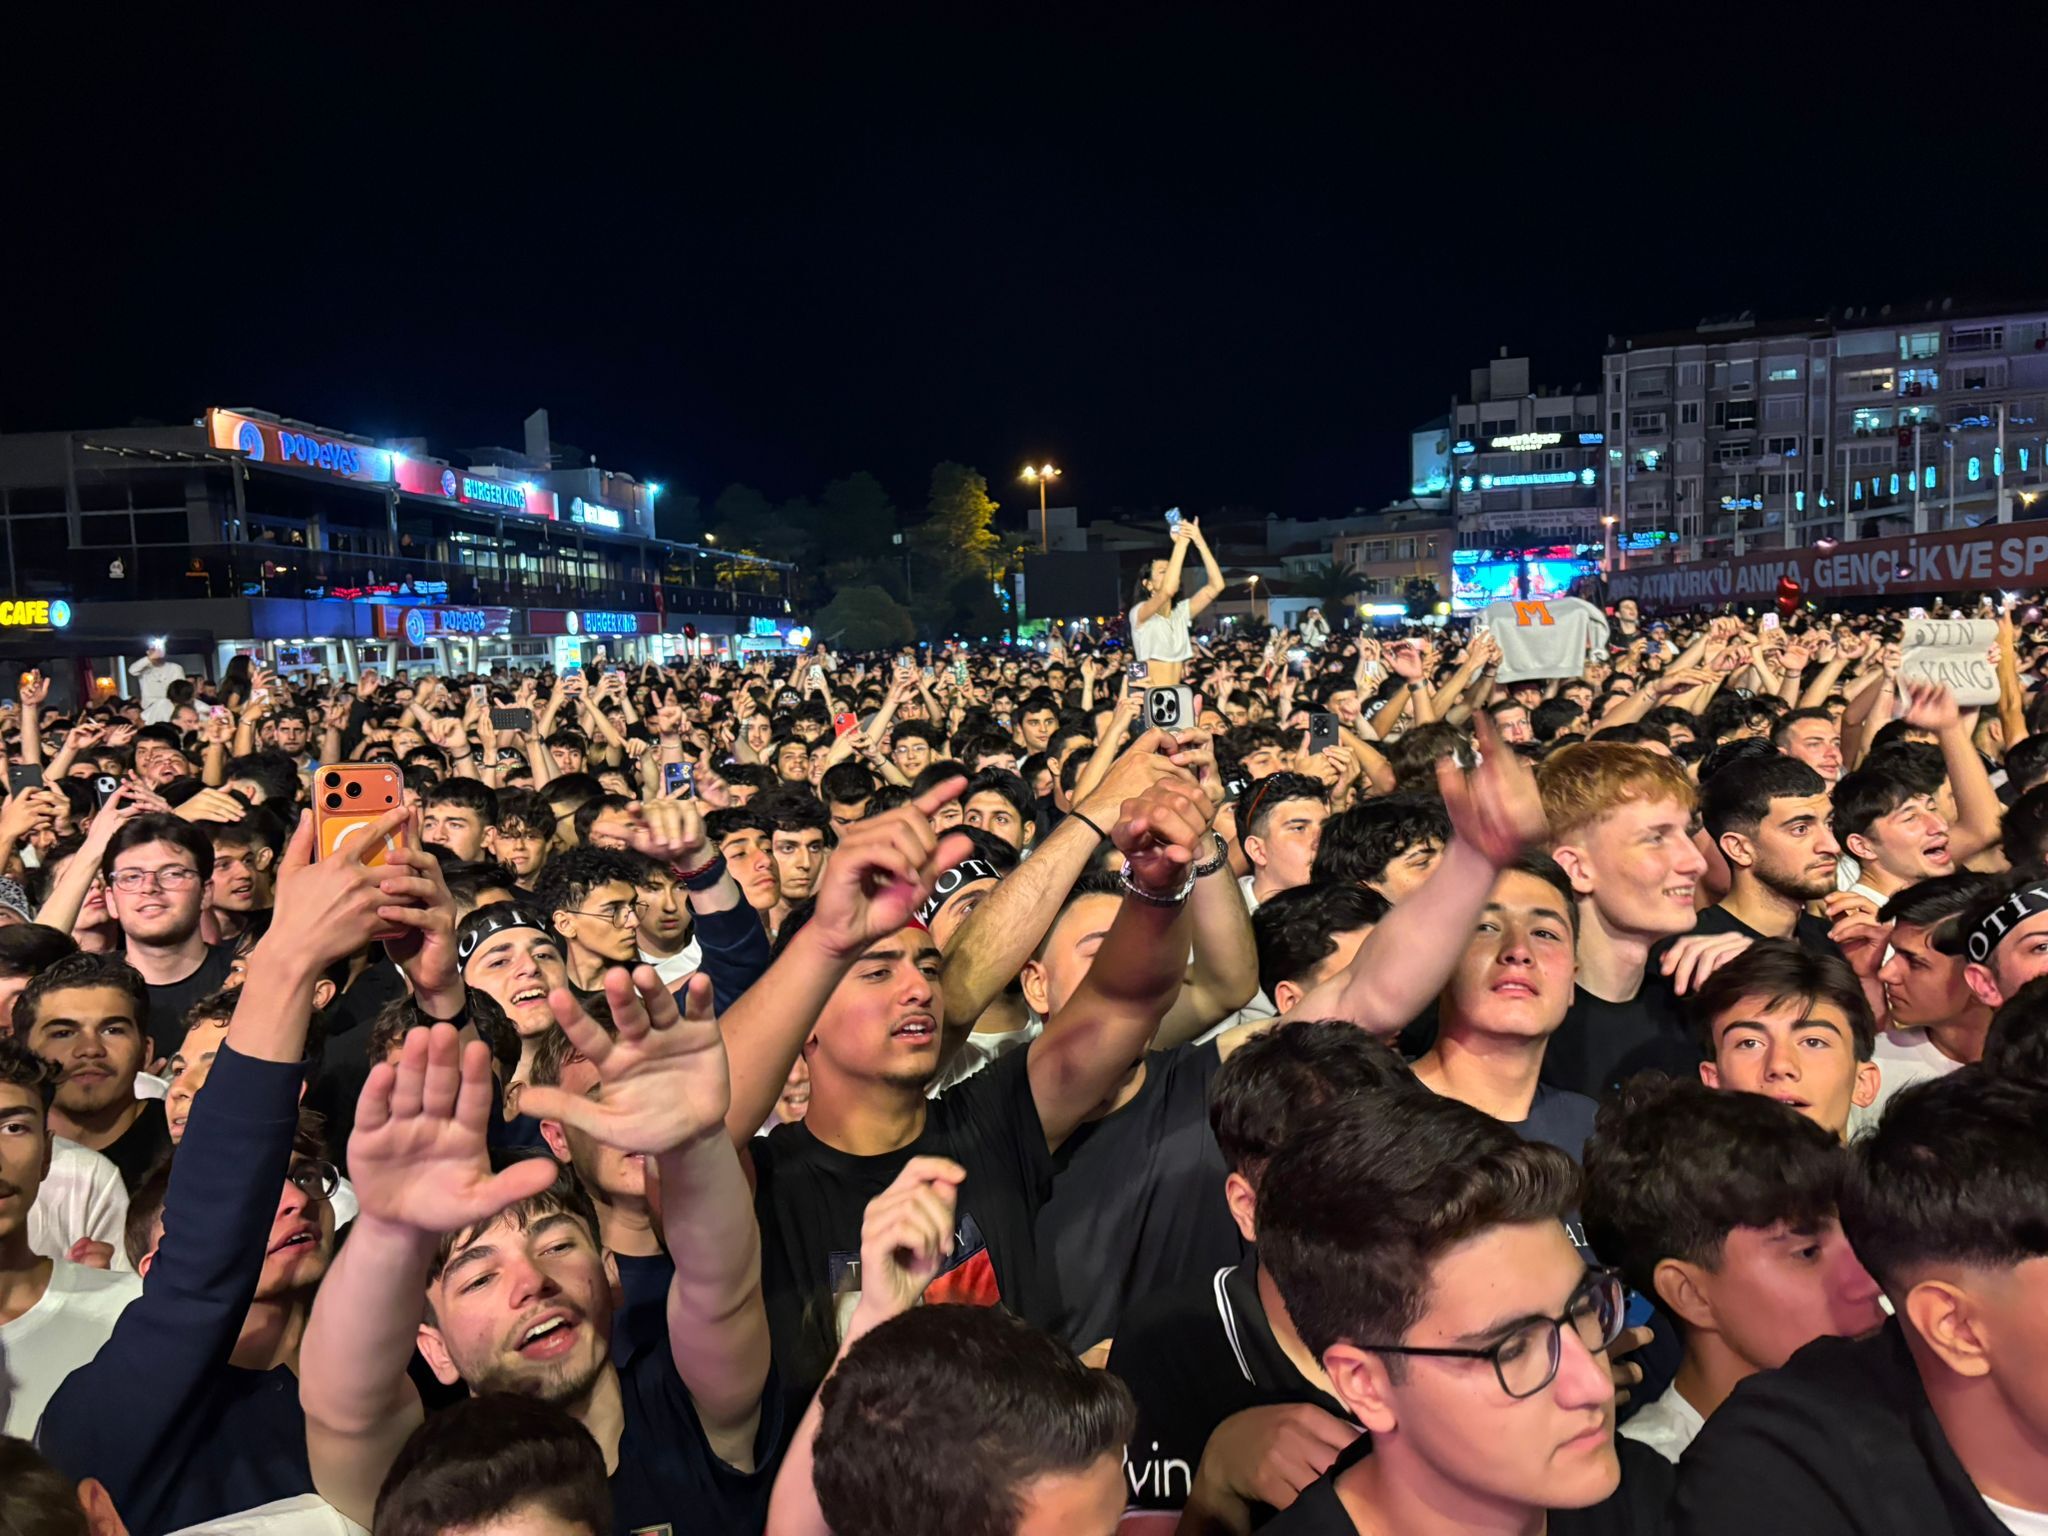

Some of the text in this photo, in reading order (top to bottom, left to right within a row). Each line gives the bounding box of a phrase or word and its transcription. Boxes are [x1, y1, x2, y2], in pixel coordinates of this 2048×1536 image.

[462, 477, 526, 508] BURGER KING
[1814, 539, 1941, 594] GENÇLİK
[1945, 541, 1993, 580] VE
[0, 600, 49, 626] CAFE
[583, 612, 638, 633] BURGER KING
[1513, 602, 1555, 626] M
[1926, 622, 1974, 646] YIN
[1920, 660, 1993, 690] YANG
